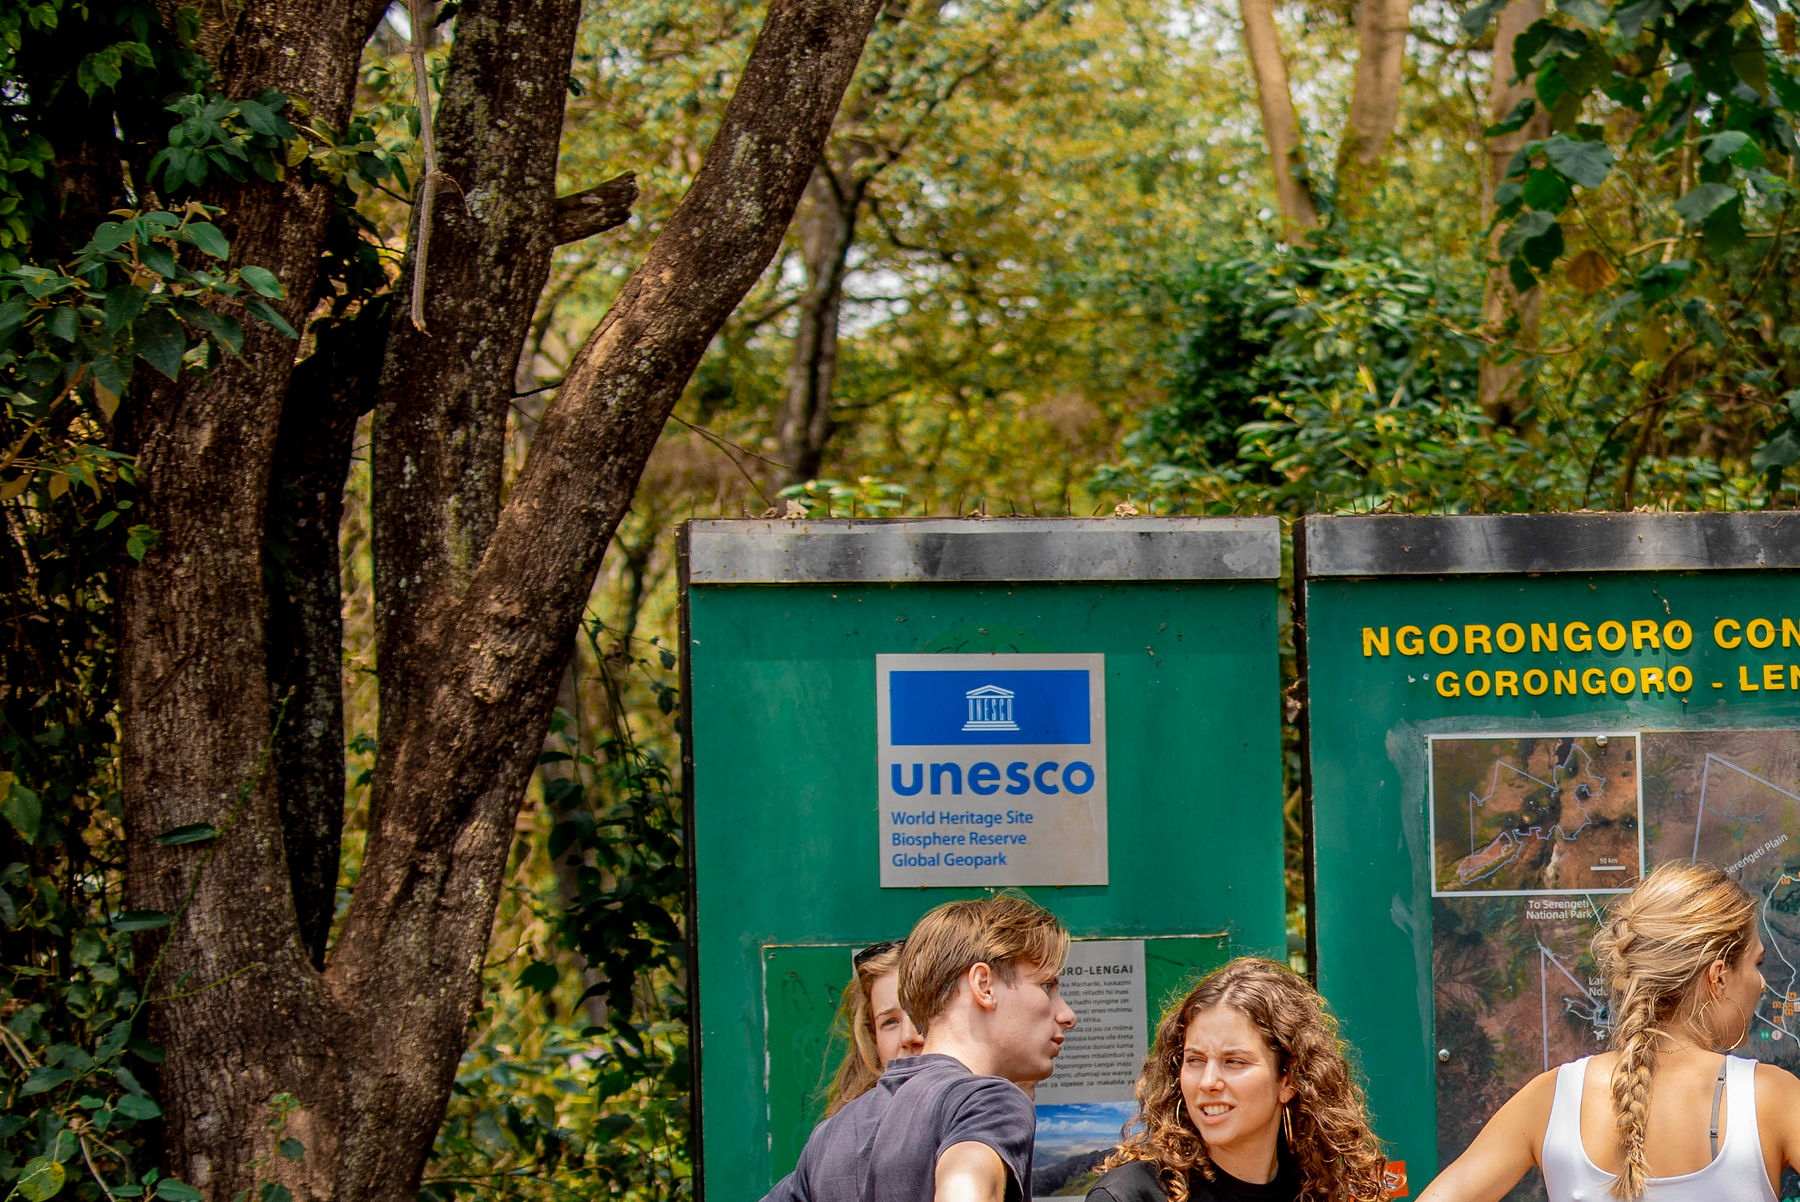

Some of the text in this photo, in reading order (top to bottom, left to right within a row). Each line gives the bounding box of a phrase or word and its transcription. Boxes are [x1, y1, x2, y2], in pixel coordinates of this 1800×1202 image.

[1362, 619, 1694, 658] NGORONGORO
[1435, 665, 1694, 697] GORONGORO
[968, 698, 1013, 721] UNESCO
[891, 761, 1095, 796] unesco
[891, 810, 1034, 827] World Heritage Site
[891, 832, 1027, 848] Biosphere Reserve
[1764, 833, 1788, 853] Plain
[892, 852, 1007, 869] Global Geopark
[1528, 899, 1589, 911] To Serengeti
[1526, 910, 1592, 920] National Park
[1059, 965, 1134, 976] ORO-LENGAI
